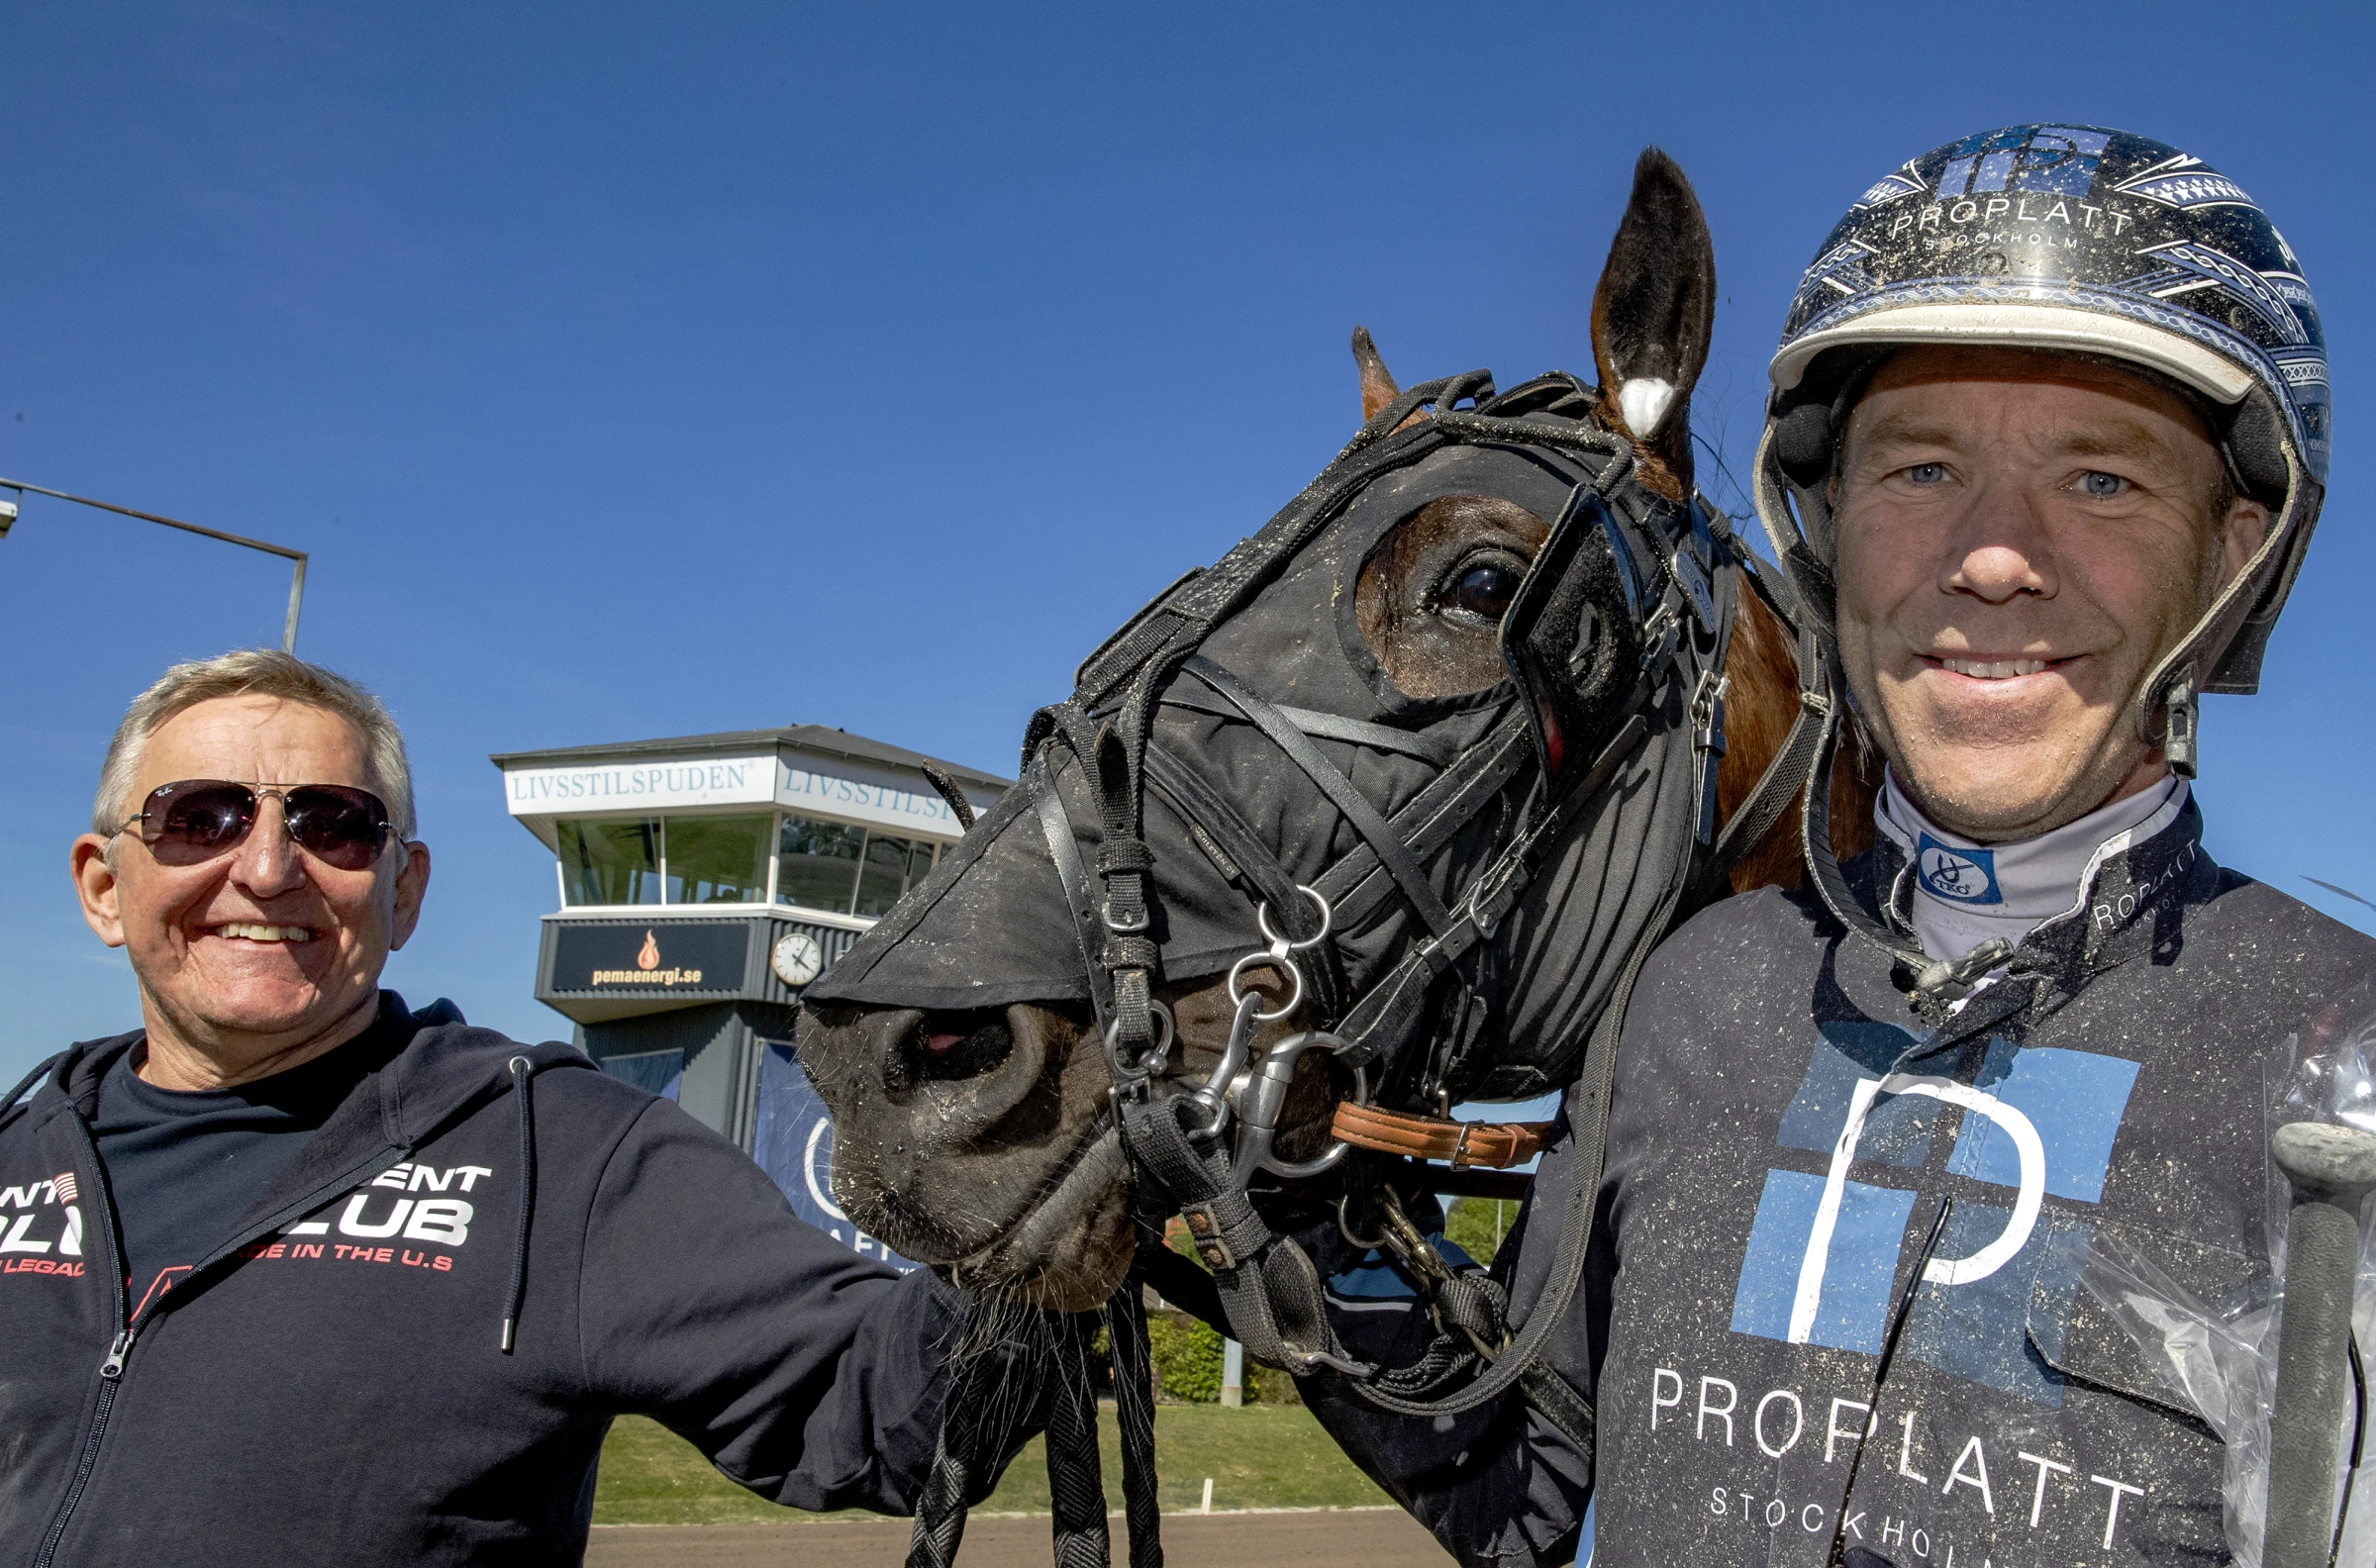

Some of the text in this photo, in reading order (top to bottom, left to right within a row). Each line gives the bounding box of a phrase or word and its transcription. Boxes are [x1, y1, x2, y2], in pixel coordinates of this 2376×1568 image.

[1892, 198, 2132, 240] PROPLATT
[512, 763, 745, 801] LIVSSTILSPUDEN
[592, 967, 702, 986] pemaenergi.se
[290, 1243, 325, 1259] IN
[334, 1244, 394, 1263] THE
[1651, 1367, 2145, 1551] PROPLATT
